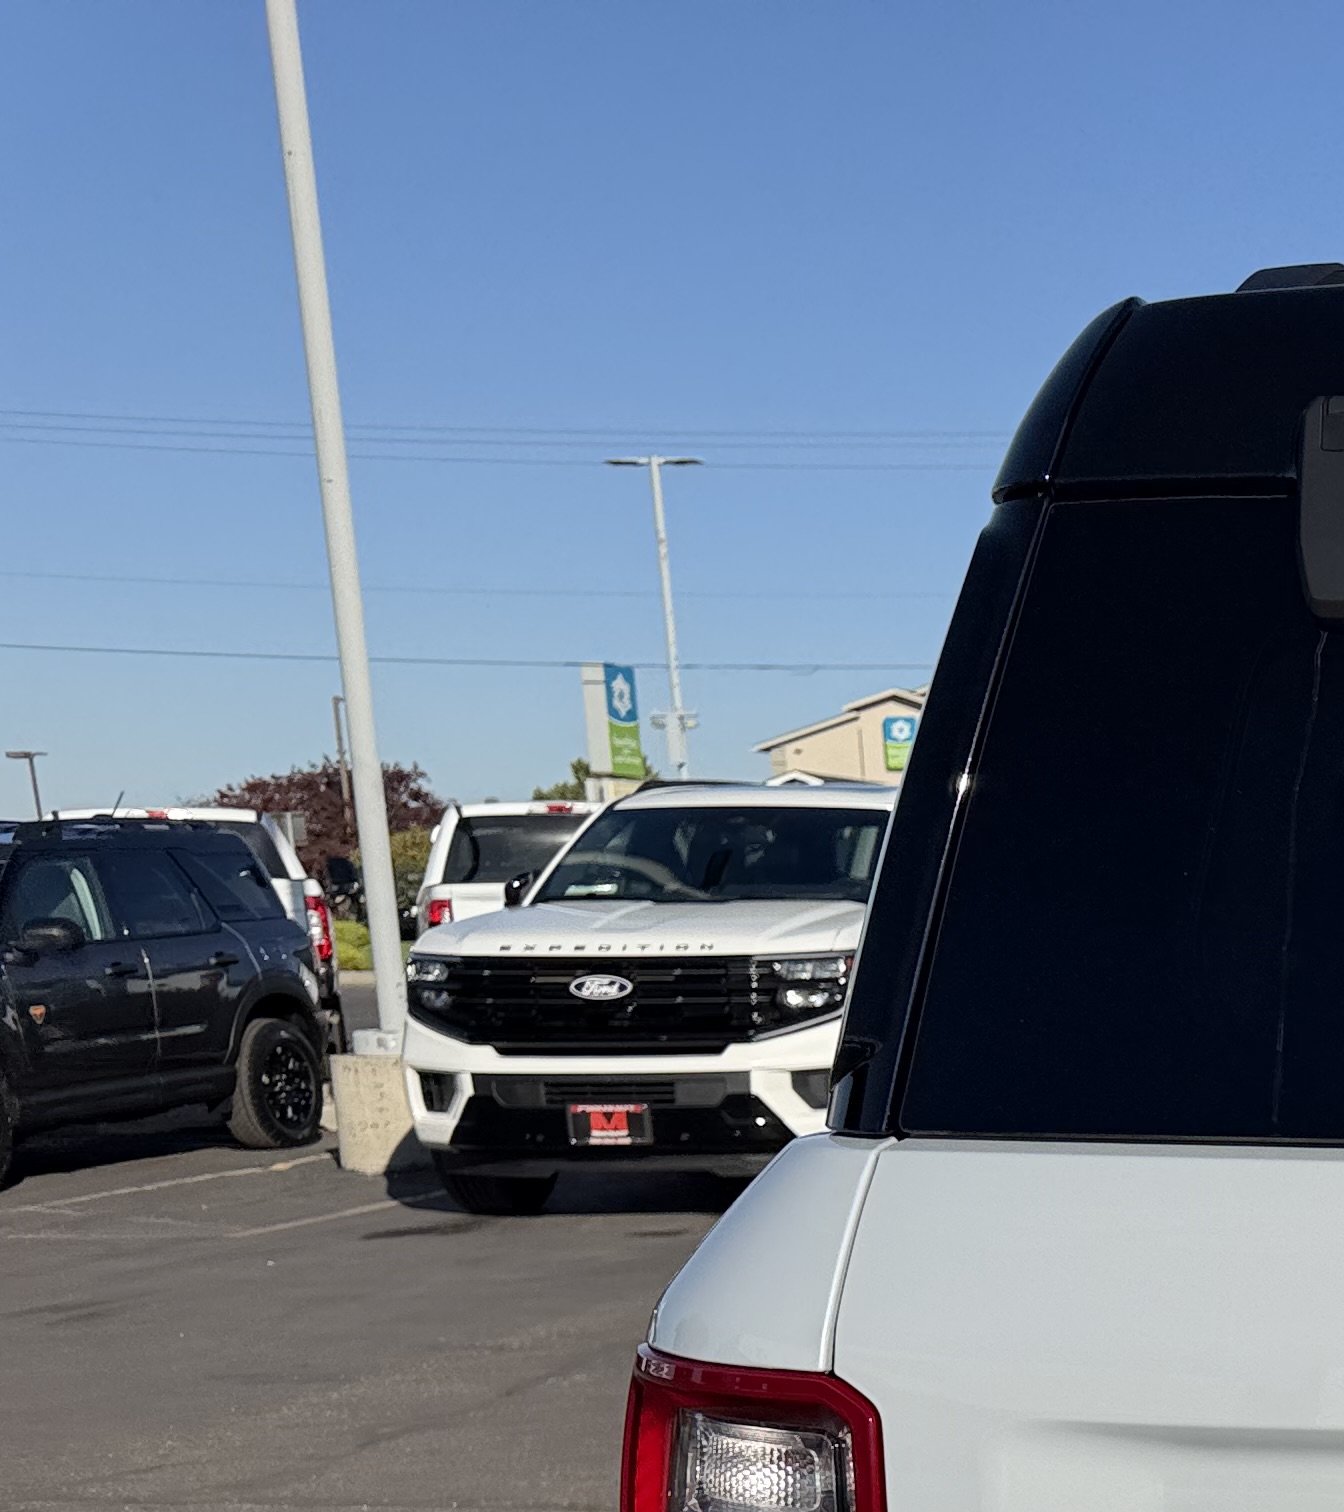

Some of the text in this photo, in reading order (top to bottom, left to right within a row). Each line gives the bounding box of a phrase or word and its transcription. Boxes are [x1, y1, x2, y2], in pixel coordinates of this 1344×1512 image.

[499, 943, 714, 952] EXPEDITION
[580, 978, 622, 997] Ford
[590, 1111, 628, 1130] M
